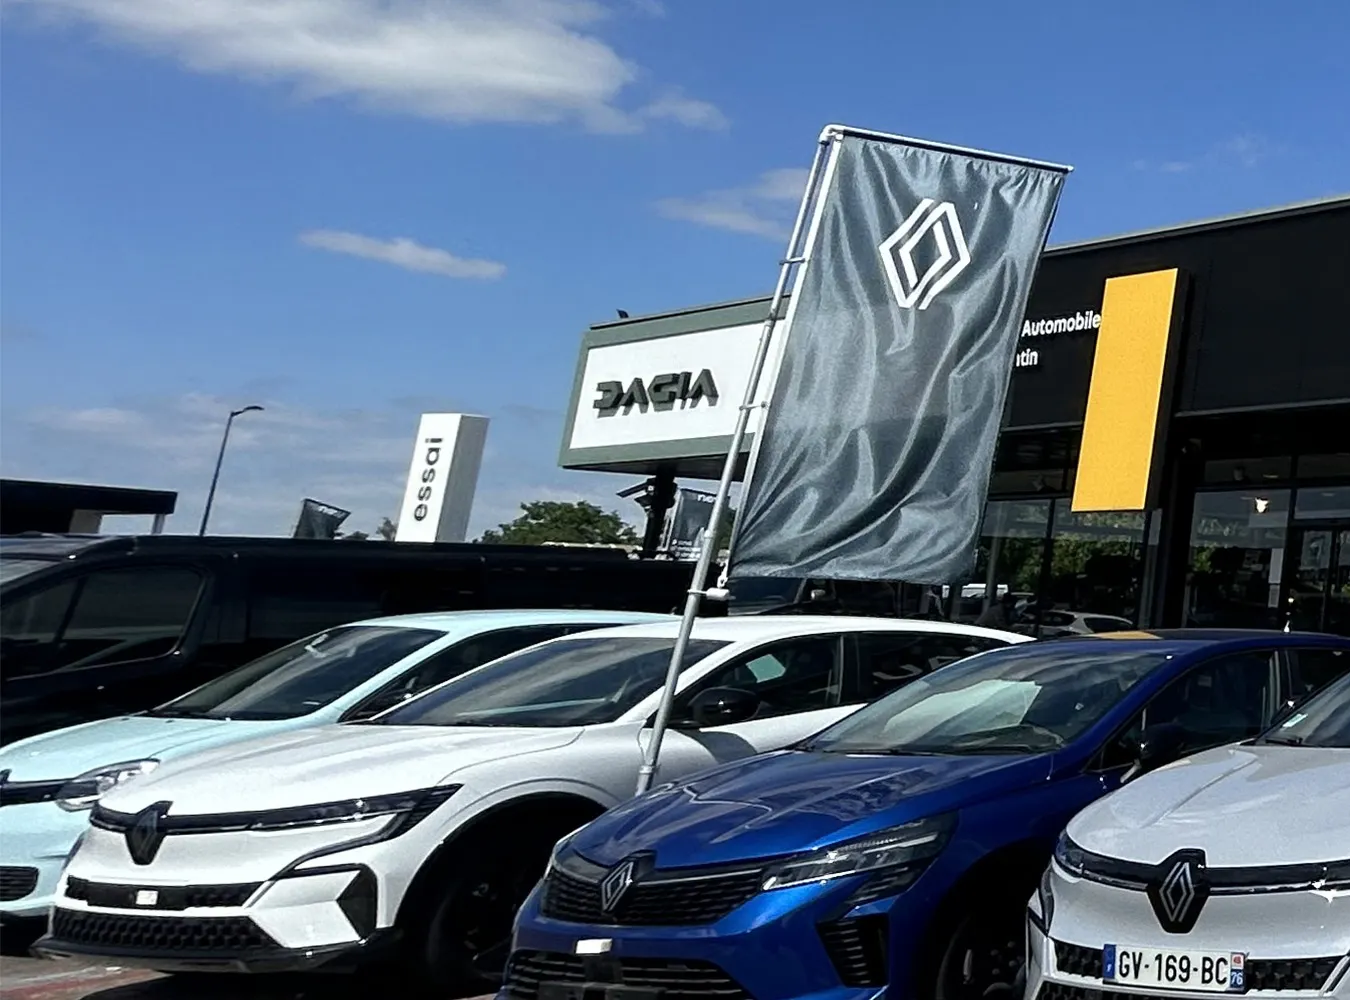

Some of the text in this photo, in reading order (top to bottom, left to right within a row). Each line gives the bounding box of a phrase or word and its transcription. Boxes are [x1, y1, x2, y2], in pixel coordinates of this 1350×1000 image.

[593, 368, 719, 417] DACIA
[413, 437, 443, 522] essai
[1119, 950, 1228, 985] GV-169-BC
[1231, 971, 1244, 986] 76
